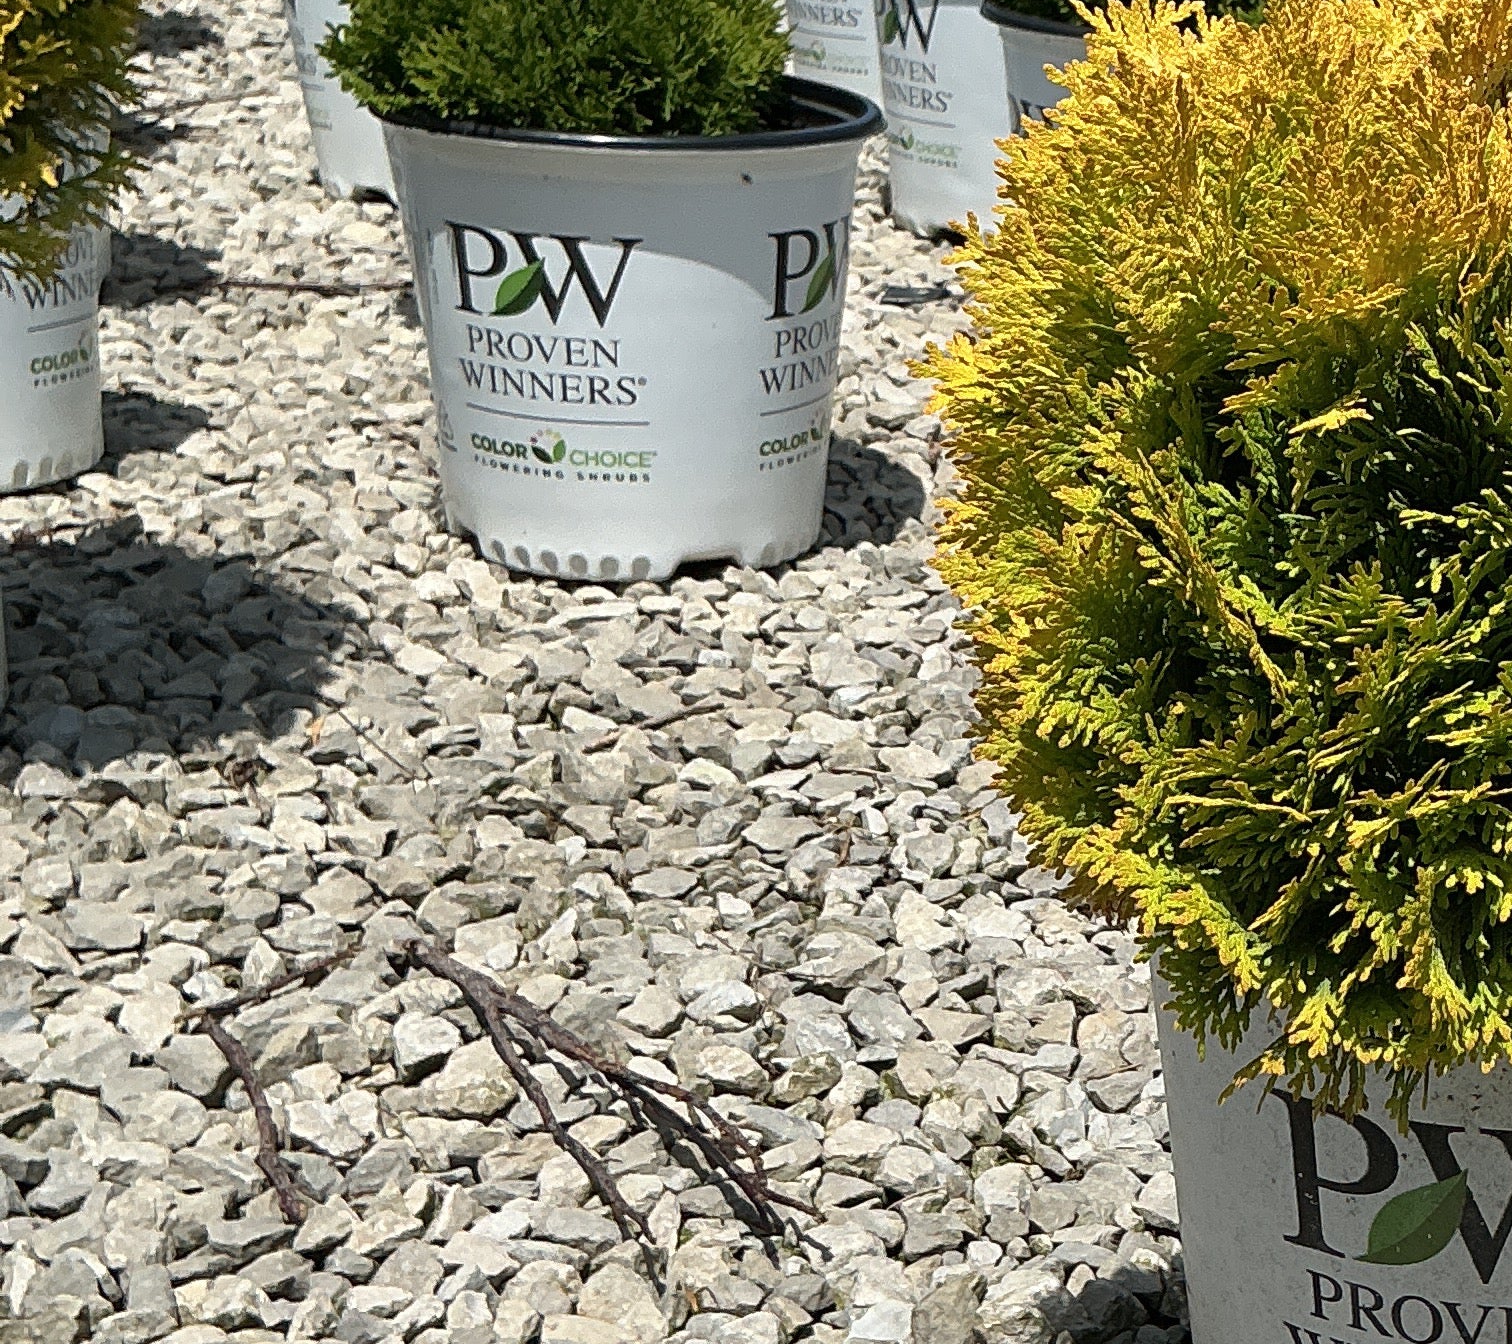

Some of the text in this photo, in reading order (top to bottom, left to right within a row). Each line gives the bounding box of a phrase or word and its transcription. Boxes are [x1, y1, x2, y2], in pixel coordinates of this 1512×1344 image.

[445, 220, 644, 329] PW
[467, 323, 620, 369] PROVEN
[775, 313, 840, 358] PROVE
[760, 348, 838, 395] WINNE
[471, 432, 652, 468] COLOR CHOICE
